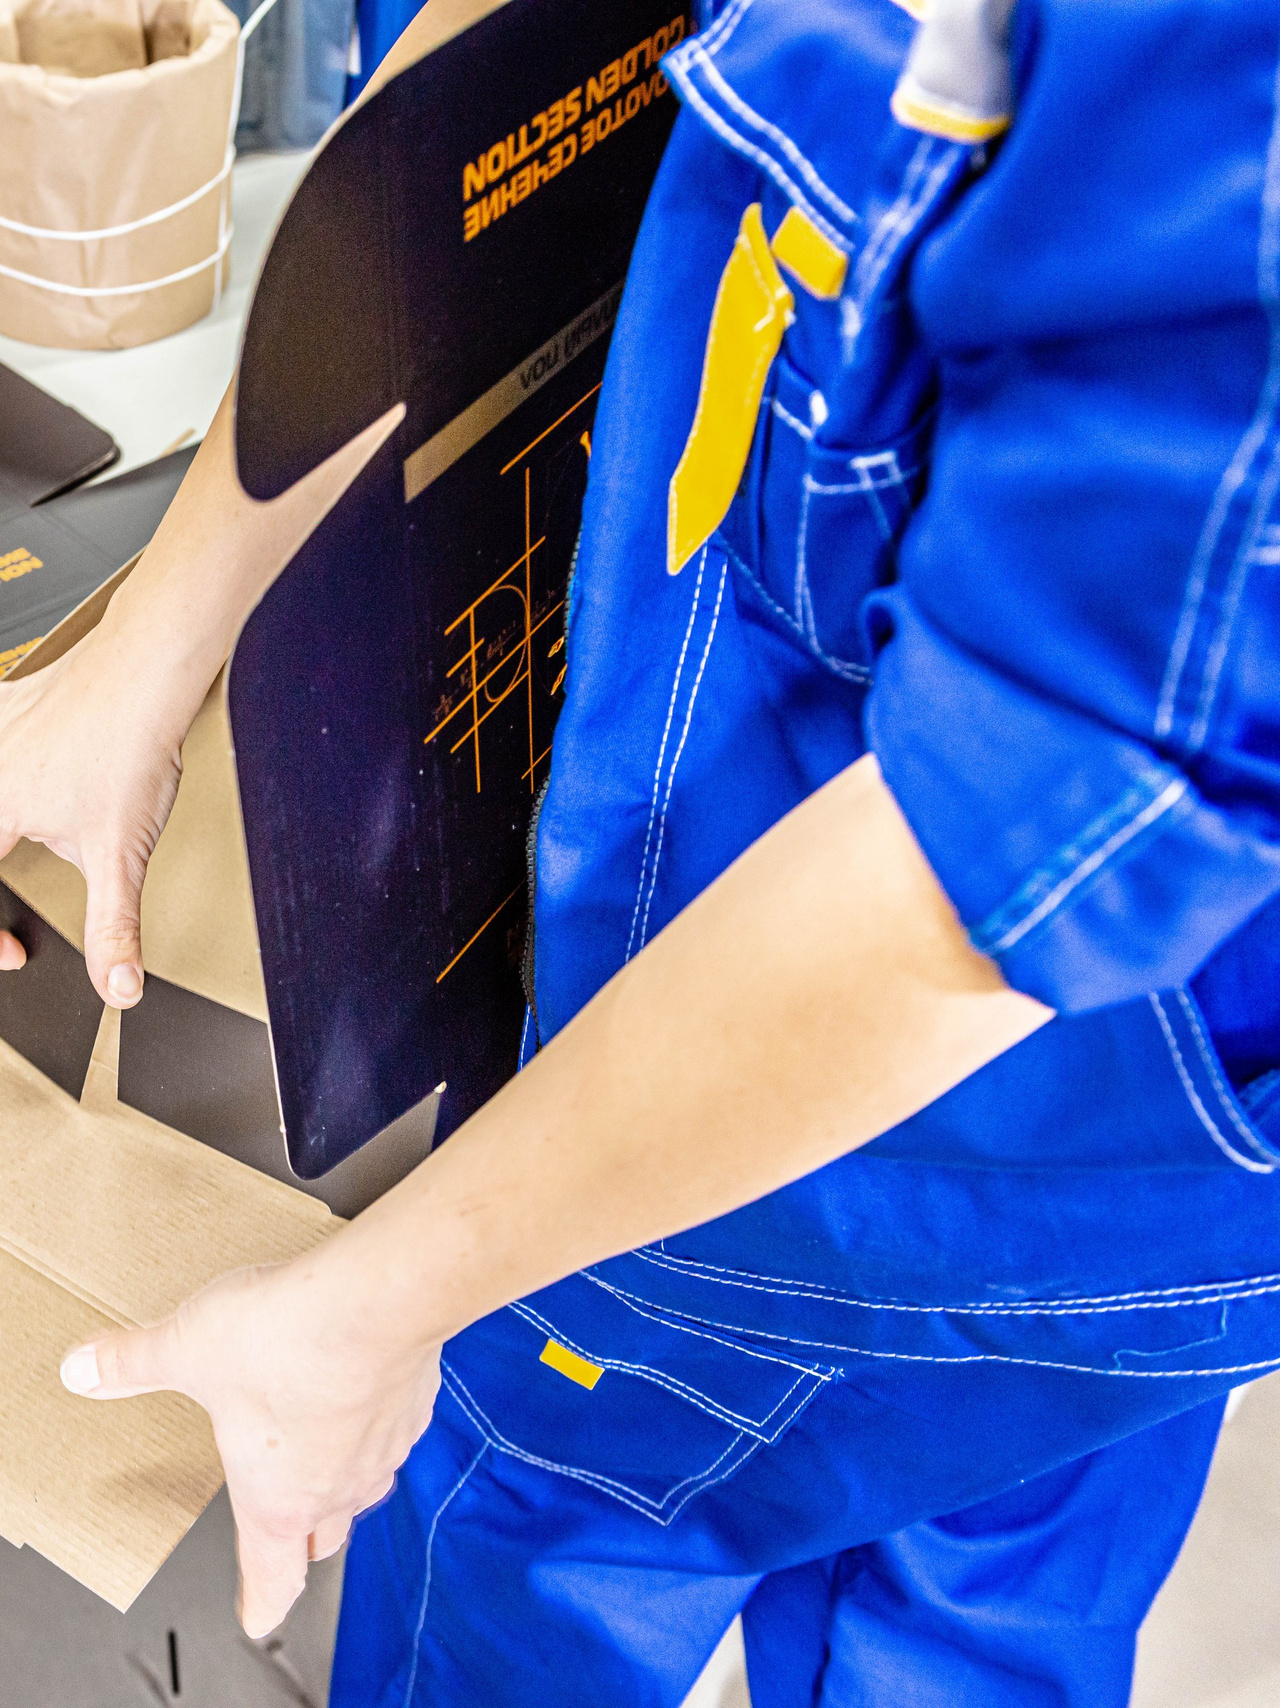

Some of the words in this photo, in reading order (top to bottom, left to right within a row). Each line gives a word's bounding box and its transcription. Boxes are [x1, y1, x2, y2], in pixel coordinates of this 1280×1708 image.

[580, 69, 669, 155] ОЛОТОЕ
[585, 14, 685, 113] GOLDEN
[463, 85, 583, 201] SECTION
[463, 132, 578, 243] СЕЧЕНИЕ
